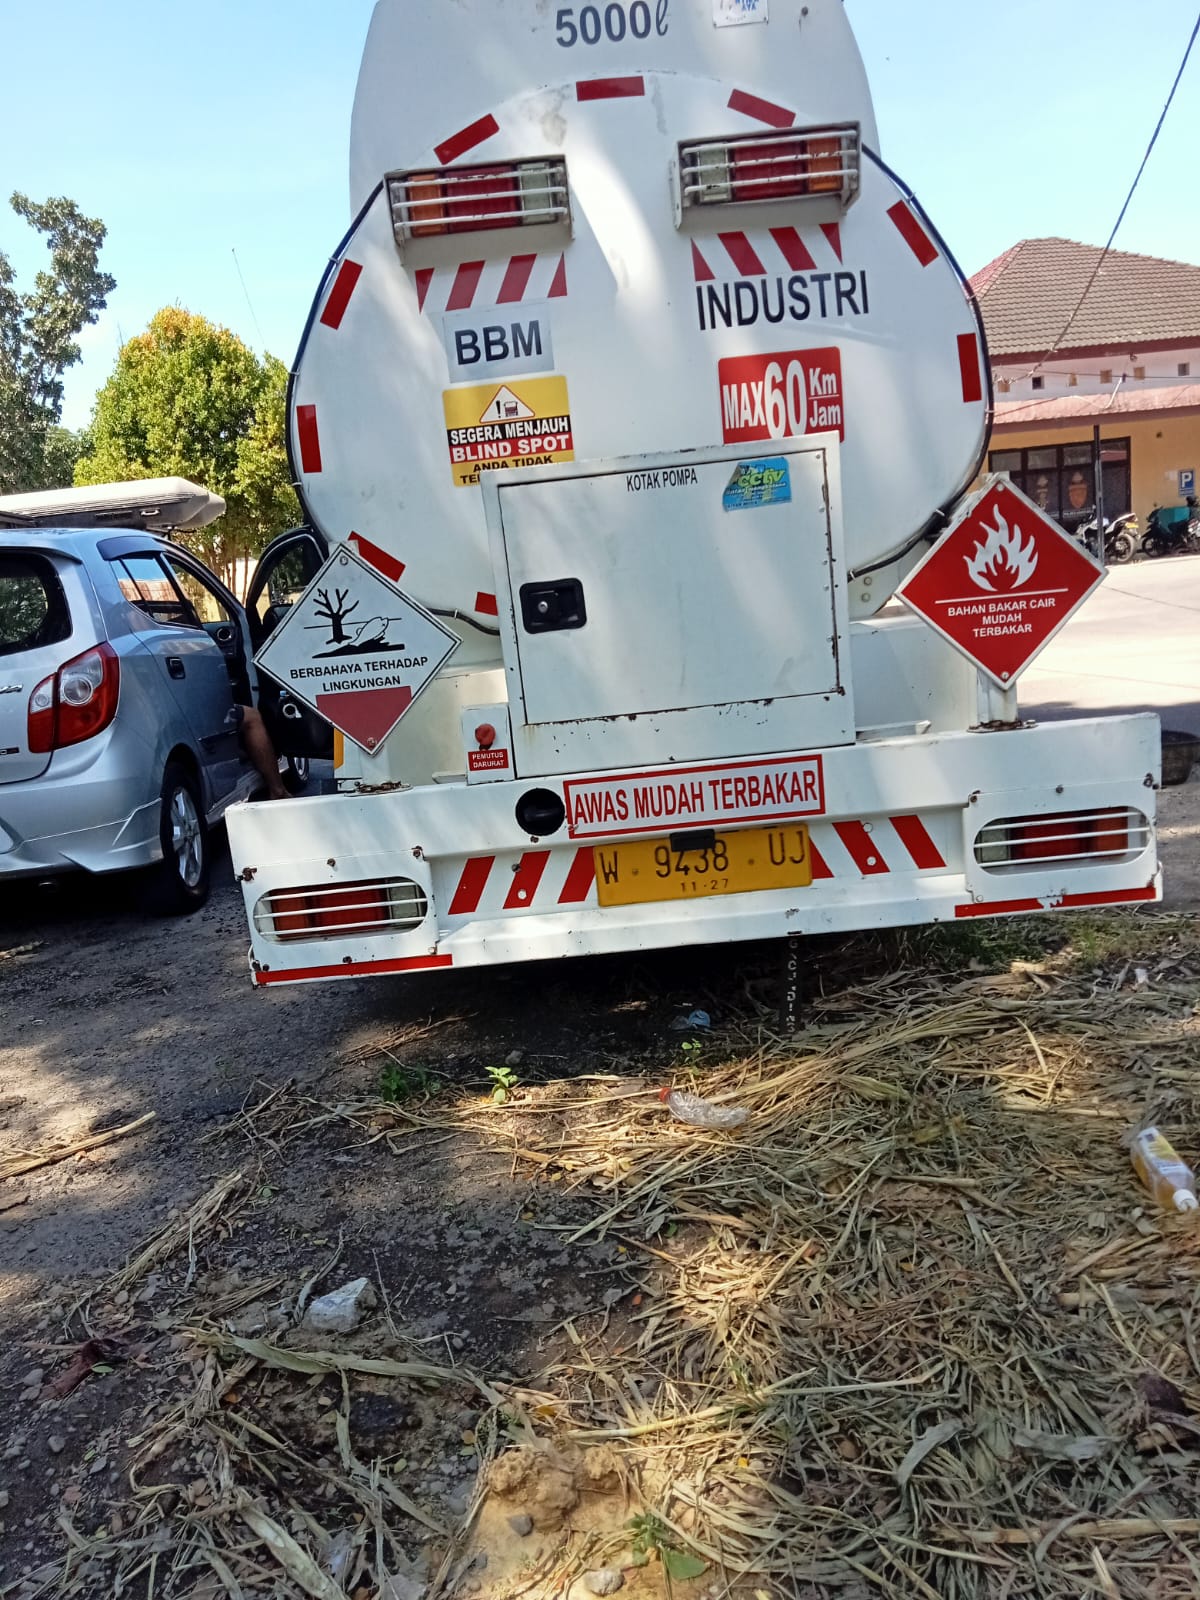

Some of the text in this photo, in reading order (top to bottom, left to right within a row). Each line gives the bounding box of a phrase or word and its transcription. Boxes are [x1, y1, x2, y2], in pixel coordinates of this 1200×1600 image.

[696, 270, 870, 331] INDUSTRI
[455, 320, 543, 365] BBM
[723, 360, 837, 439] MAX 60 Km
[809, 400, 841, 428] Jam
[450, 417, 569, 445] SEGERA MENJAUH
[452, 435, 569, 462] BLIND SPOT
[473, 455, 553, 473] ANDA TIDAK
[626, 467, 698, 492] KOTAK POMPA
[1181, 472, 1192, 488] P
[948, 597, 1056, 616] BAHAN BAKAR CAIR
[972, 623, 1033, 638] TERBAKAR
[982, 613, 1022, 625] MUDAH
[290, 656, 428, 679] BERBAHAYA TERHADAP
[322, 676, 401, 692] LINGKUNGAN
[472, 751, 504, 760] PEMUTUS
[473, 760, 505, 768] DARURAT
[574, 770, 818, 825] AWAS MUDAH TERBAKAR
[599, 831, 806, 884] W 9438 UJ
